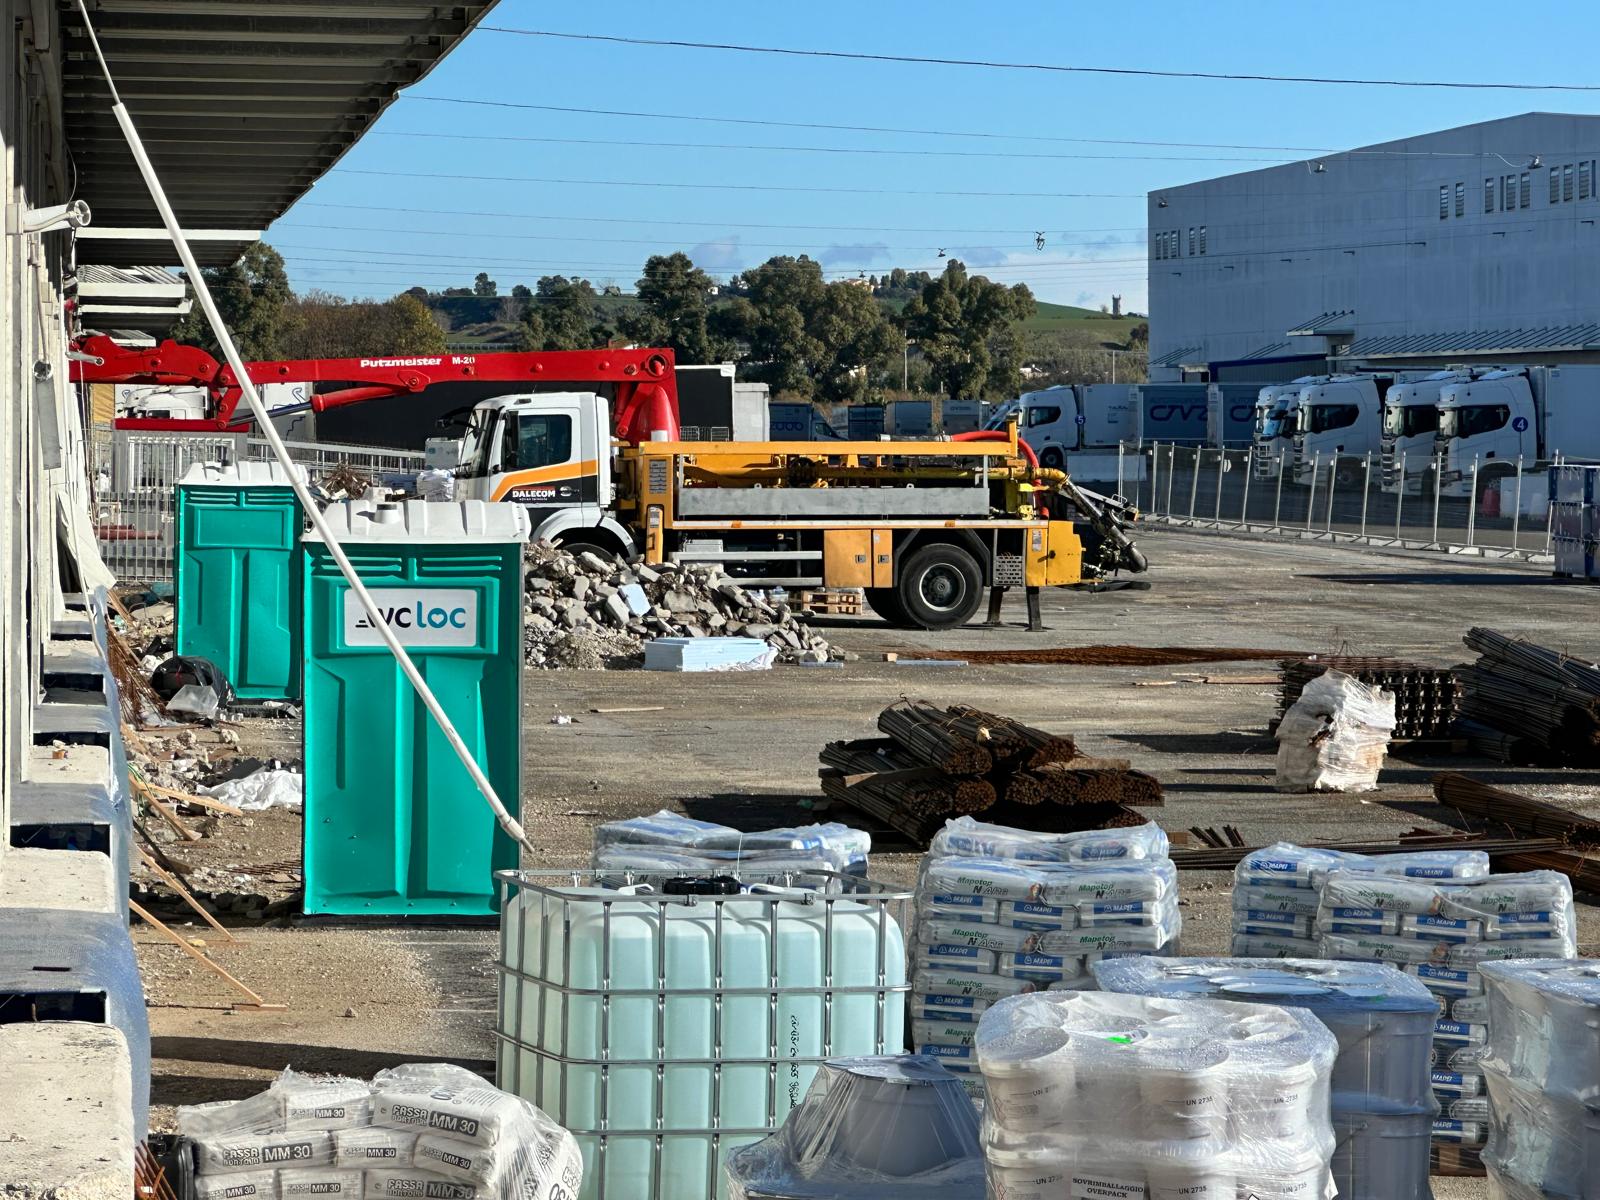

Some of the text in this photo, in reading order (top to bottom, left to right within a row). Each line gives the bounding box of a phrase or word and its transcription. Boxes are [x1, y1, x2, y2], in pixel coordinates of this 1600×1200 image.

[360, 357, 442, 368] Putzmeister
[1077, 416, 1085, 425] 5
[1516, 418, 1526, 430] 4
[512, 490, 556, 498] DALECOM
[1031, 905, 1053, 914] MAPEI
[1112, 904, 1134, 913] MAPEI
[1435, 918, 1457, 927] MAPEI
[1031, 958, 1053, 967] MAPEI
[1436, 969, 1459, 979] MAPEI
[944, 1027, 976, 1037] Mapeto
[1438, 1023, 1461, 1033] MAPEI
[939, 1046, 961, 1056] MAPEI
[1431, 1073, 1453, 1083] MAPEI
[1185, 1098, 1198, 1106] UN
[315, 1108, 332, 1119] MM
[332, 1108, 344, 1118] 30
[392, 1104, 477, 1135] FASSA MM 30
[1431, 1120, 1453, 1129] MAPEI
[223, 1144, 311, 1162] FASSA MM 30
[366, 1148, 384, 1158] MM
[384, 1148, 396, 1157] 30
[443, 1153, 471, 1169] MM 30
[1035, 1177, 1048, 1186] UN
[1072, 1177, 1145, 1193] SOVRIMBALLAGGIO
[226, 1187, 243, 1198] MM
[243, 1185, 255, 1195] 30
[311, 1184, 328, 1193] MM
[329, 1183, 340, 1192] 30
[387, 1179, 474, 1199] FASSA MM 30
[1086, 1187, 1129, 1199] OVERPACK
[1178, 1184, 1208, 1196] UN 2735
